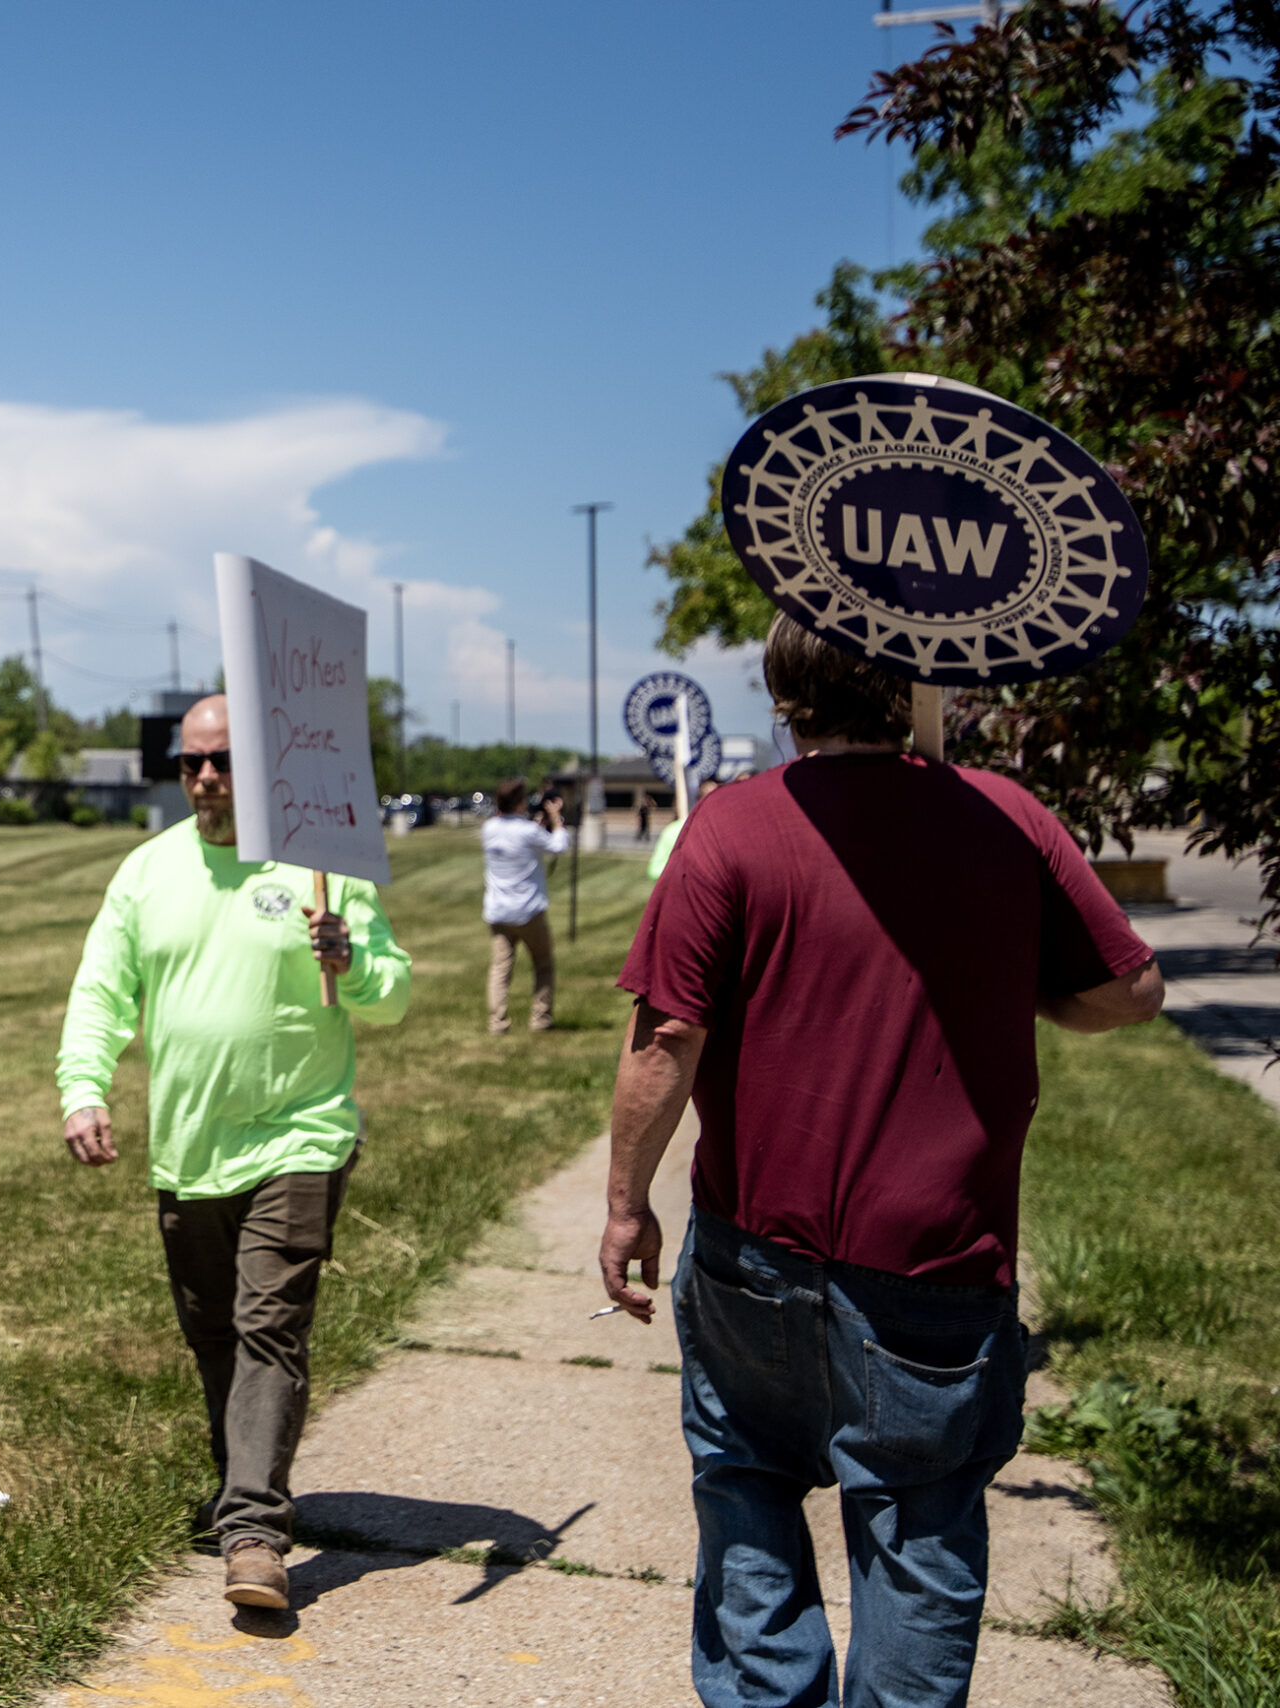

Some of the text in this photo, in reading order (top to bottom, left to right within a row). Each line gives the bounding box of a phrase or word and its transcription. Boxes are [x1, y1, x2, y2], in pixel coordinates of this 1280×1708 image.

[849, 444, 878, 460] AND
[884, 443, 995, 475] AGRICULTURAL
[797, 453, 845, 502] AEROSPACE
[998, 471, 1056, 532] IMPLEMENT
[842, 503, 1008, 579] UAW
[1045, 536, 1063, 588] WORKERS
[823, 574, 865, 611] UNITED
[1036, 589, 1050, 603] OF
[981, 602, 1035, 631] AMERICA
